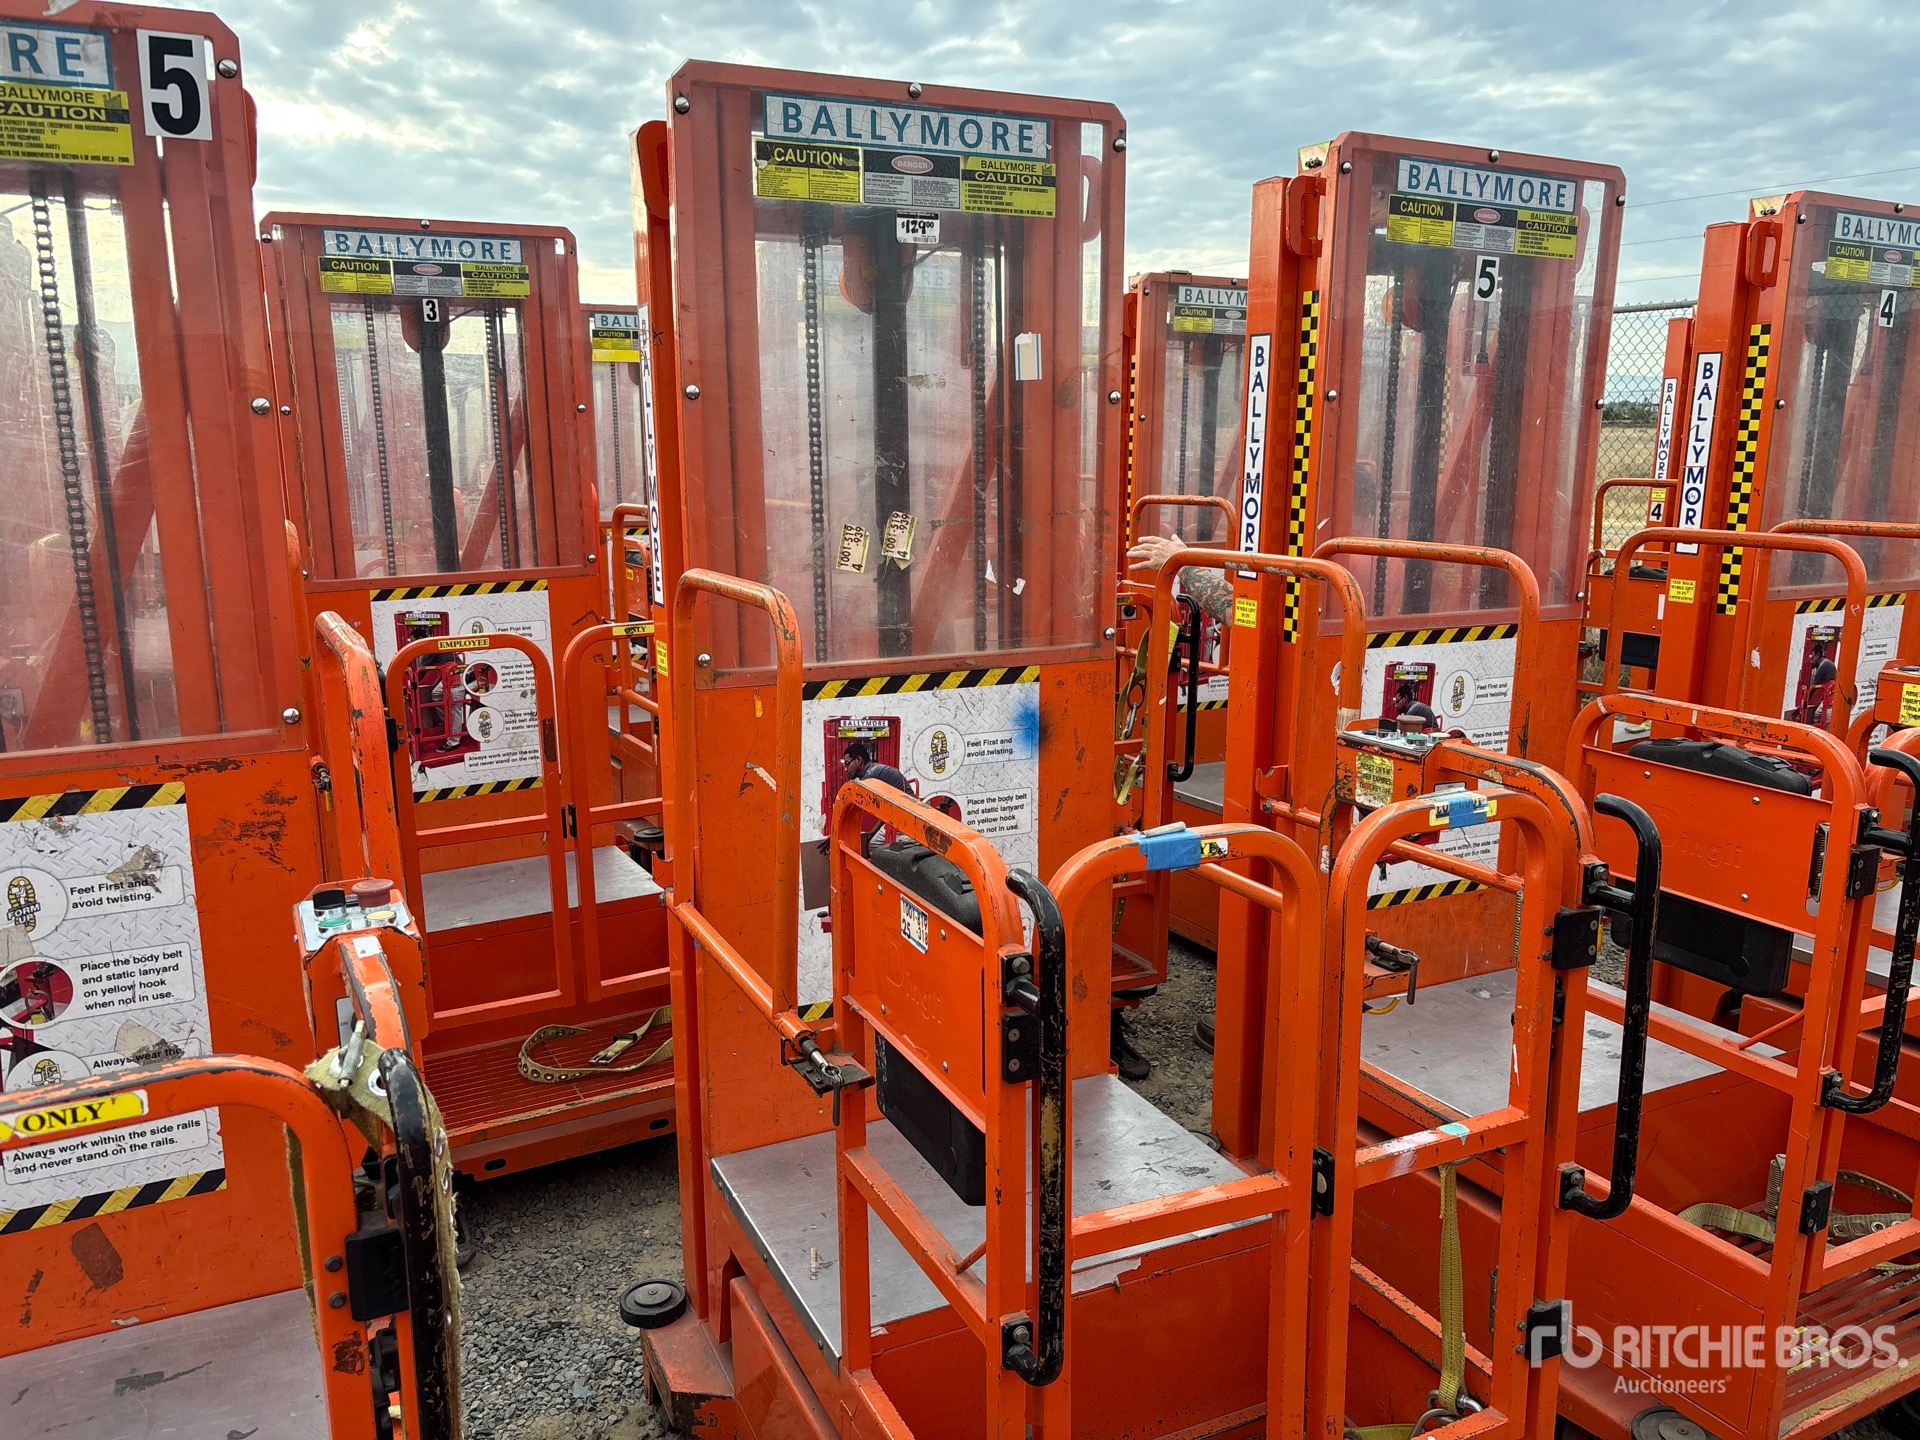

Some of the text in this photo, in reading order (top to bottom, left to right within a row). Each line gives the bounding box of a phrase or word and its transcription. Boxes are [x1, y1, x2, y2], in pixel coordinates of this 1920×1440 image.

[148, 35, 201, 135] 5
[0, 86, 95, 104] BALLYMORE
[782, 102, 1034, 153] BALLYMORE
[774, 148, 843, 165] CAUTION
[897, 160, 928, 169] DANGER
[981, 160, 1037, 173] BALLYMORE
[975, 172, 1042, 185] CAUTION
[1408, 164, 1567, 208] BALLYMORE
[1400, 201, 1444, 217] CAUTION
[1477, 212, 1497, 220] DANGER
[1530, 212, 1566, 223] BALLYMORE
[1526, 221, 1569, 233] CAUTION
[336, 233, 511, 260] BALLYMORE
[1836, 245, 1865, 257] CAUTION
[331, 260, 379, 271] CAUTION
[1477, 259, 1497, 298] 5
[425, 300, 437, 321] 3
[1181, 308, 1207, 317] CAUTION
[1880, 293, 1894, 325] 4
[1244, 345, 1265, 552] BALLYMOR
[1684, 361, 1714, 526] BALLYMOR
[1651, 504, 1662, 520] 4
[840, 525, 855, 566] 1001-519
[897, 550, 908, 558] 4
[852, 563, 863, 571] 4
[440, 639, 488, 648] EMPLOYEE
[967, 740, 981, 748] Feet
[967, 749, 985, 758] avoid
[967, 798, 984, 806] Place
[998, 794, 1013, 804] body
[981, 806, 998, 814] static
[1000, 803, 1024, 813] lanyard
[977, 817, 998, 826] yellow
[70, 879, 148, 896] Feet First and
[71, 892, 155, 910] avoid twisting.
[8, 904, 40, 919] FORM
[19, 913, 34, 924] UP
[902, 918, 911, 939] 25
[80, 949, 183, 972] Place the body belt
[82, 963, 179, 986] and static lanyard
[84, 978, 167, 998] on yellow hook
[85, 990, 174, 1011] when not in use.
[93, 1047, 184, 1070] Always wear the
[22, 1101, 106, 1132] ONLY
[13, 1118, 201, 1163] Always work within the side rails
[14, 1136, 178, 1175] and never stand on the rails.
